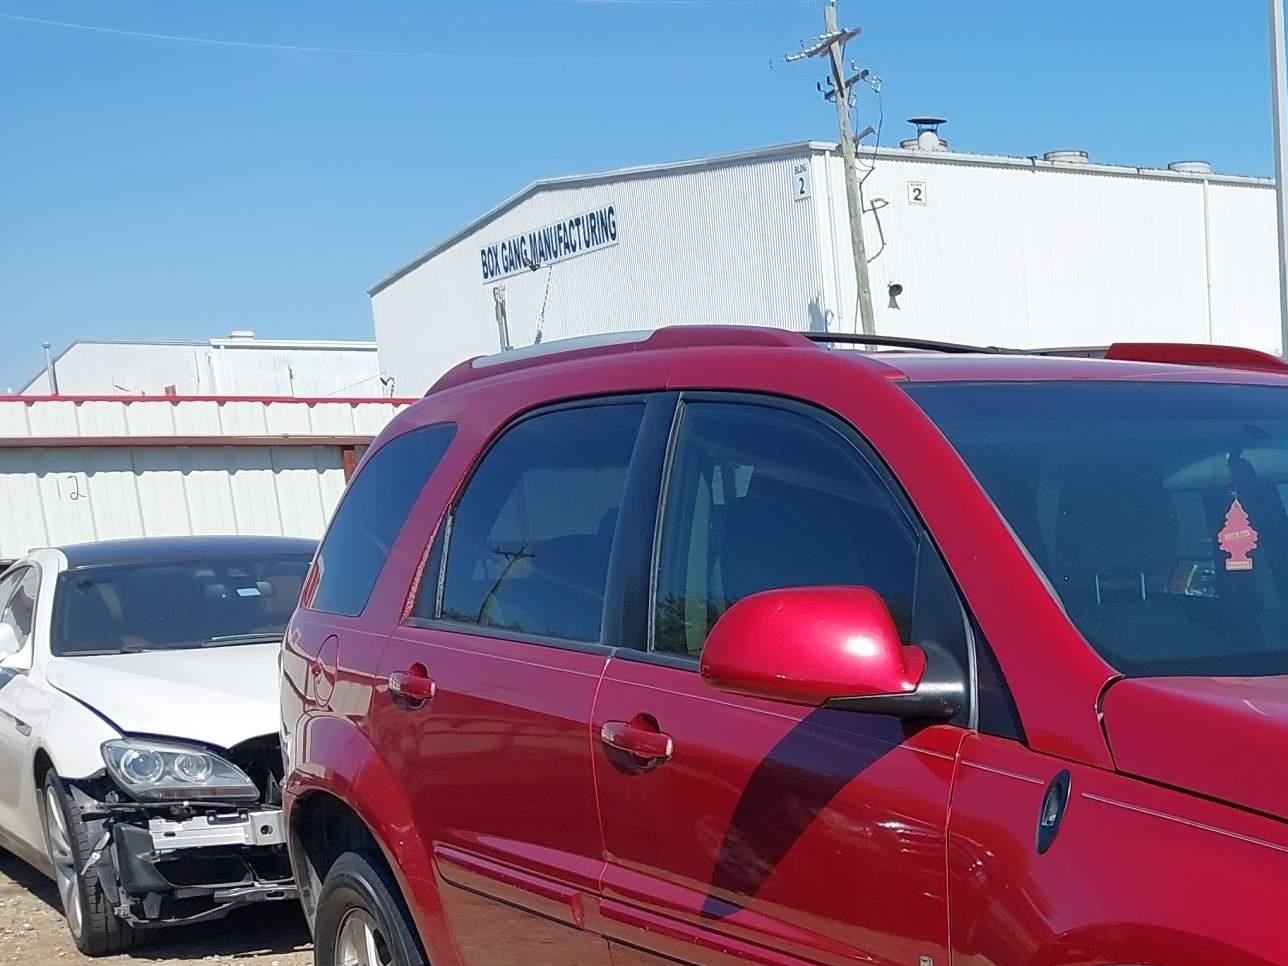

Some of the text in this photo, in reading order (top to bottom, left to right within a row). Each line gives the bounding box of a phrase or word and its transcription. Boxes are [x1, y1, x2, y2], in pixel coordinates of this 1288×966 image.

[798, 177, 806, 195] 2
[912, 188, 923, 201] 2
[481, 206, 617, 279] BOX GANG MANUFACTURING
